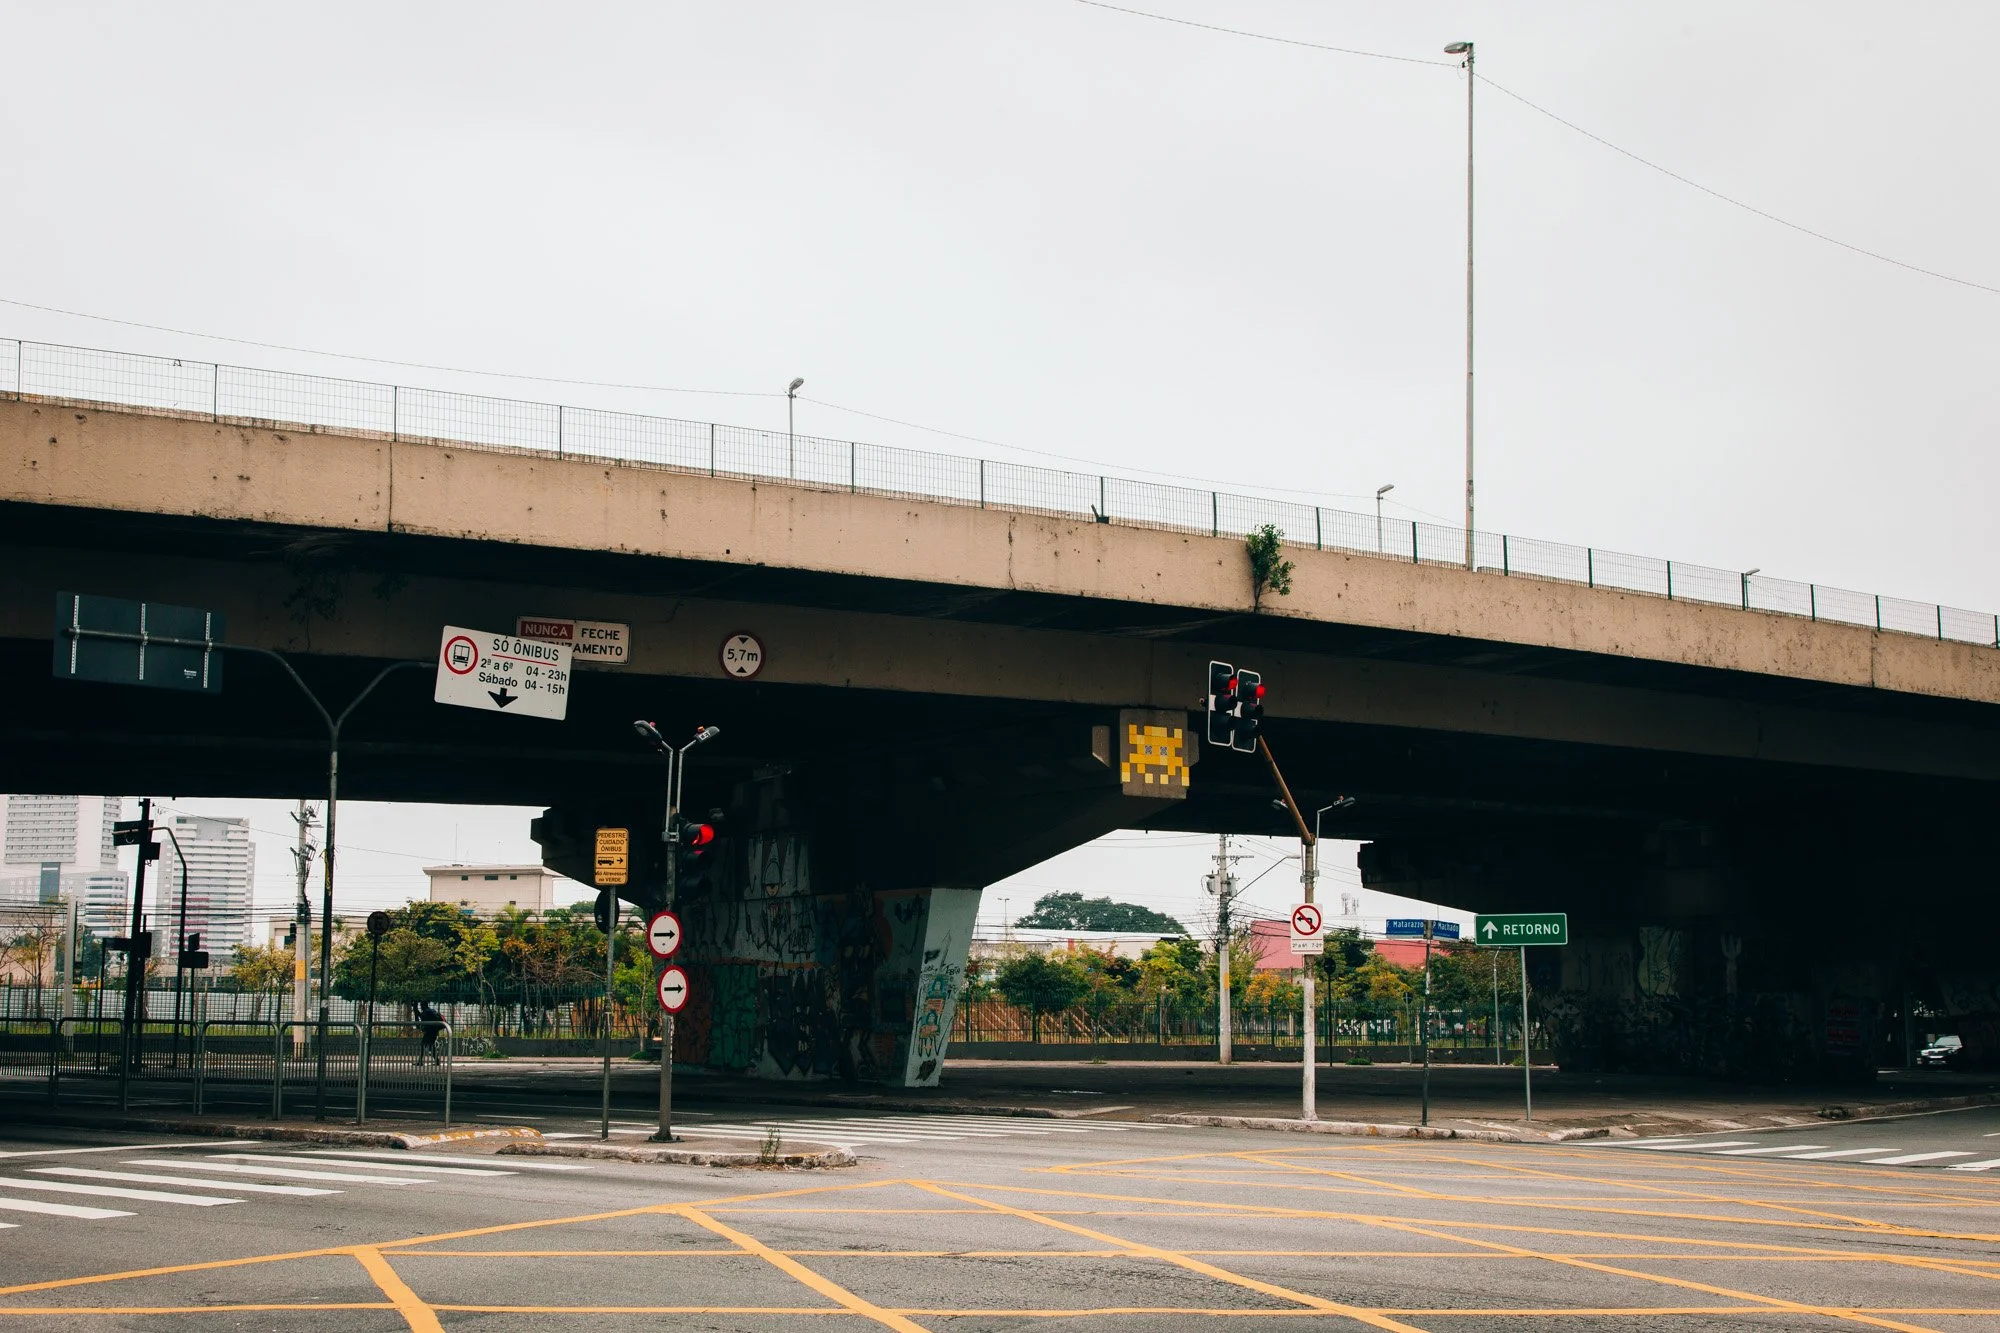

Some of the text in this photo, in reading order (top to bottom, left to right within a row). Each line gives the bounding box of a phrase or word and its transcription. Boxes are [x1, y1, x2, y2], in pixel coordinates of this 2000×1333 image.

[525, 624, 620, 640] NUNCA FECHE
[492, 636, 559, 661] SÓ ÔNIBUS
[727, 649, 758, 662] 5,7m
[494, 662, 500, 670] a
[526, 666, 538, 676] 04
[548, 669, 567, 681] 23h
[478, 672, 518, 687] Sábado
[525, 680, 537, 690] 04
[546, 683, 565, 694] 15h
[1393, 920, 1424, 928] Matarazzo
[1437, 921, 1459, 932] Machado
[1503, 923, 1560, 935] RETORNO
